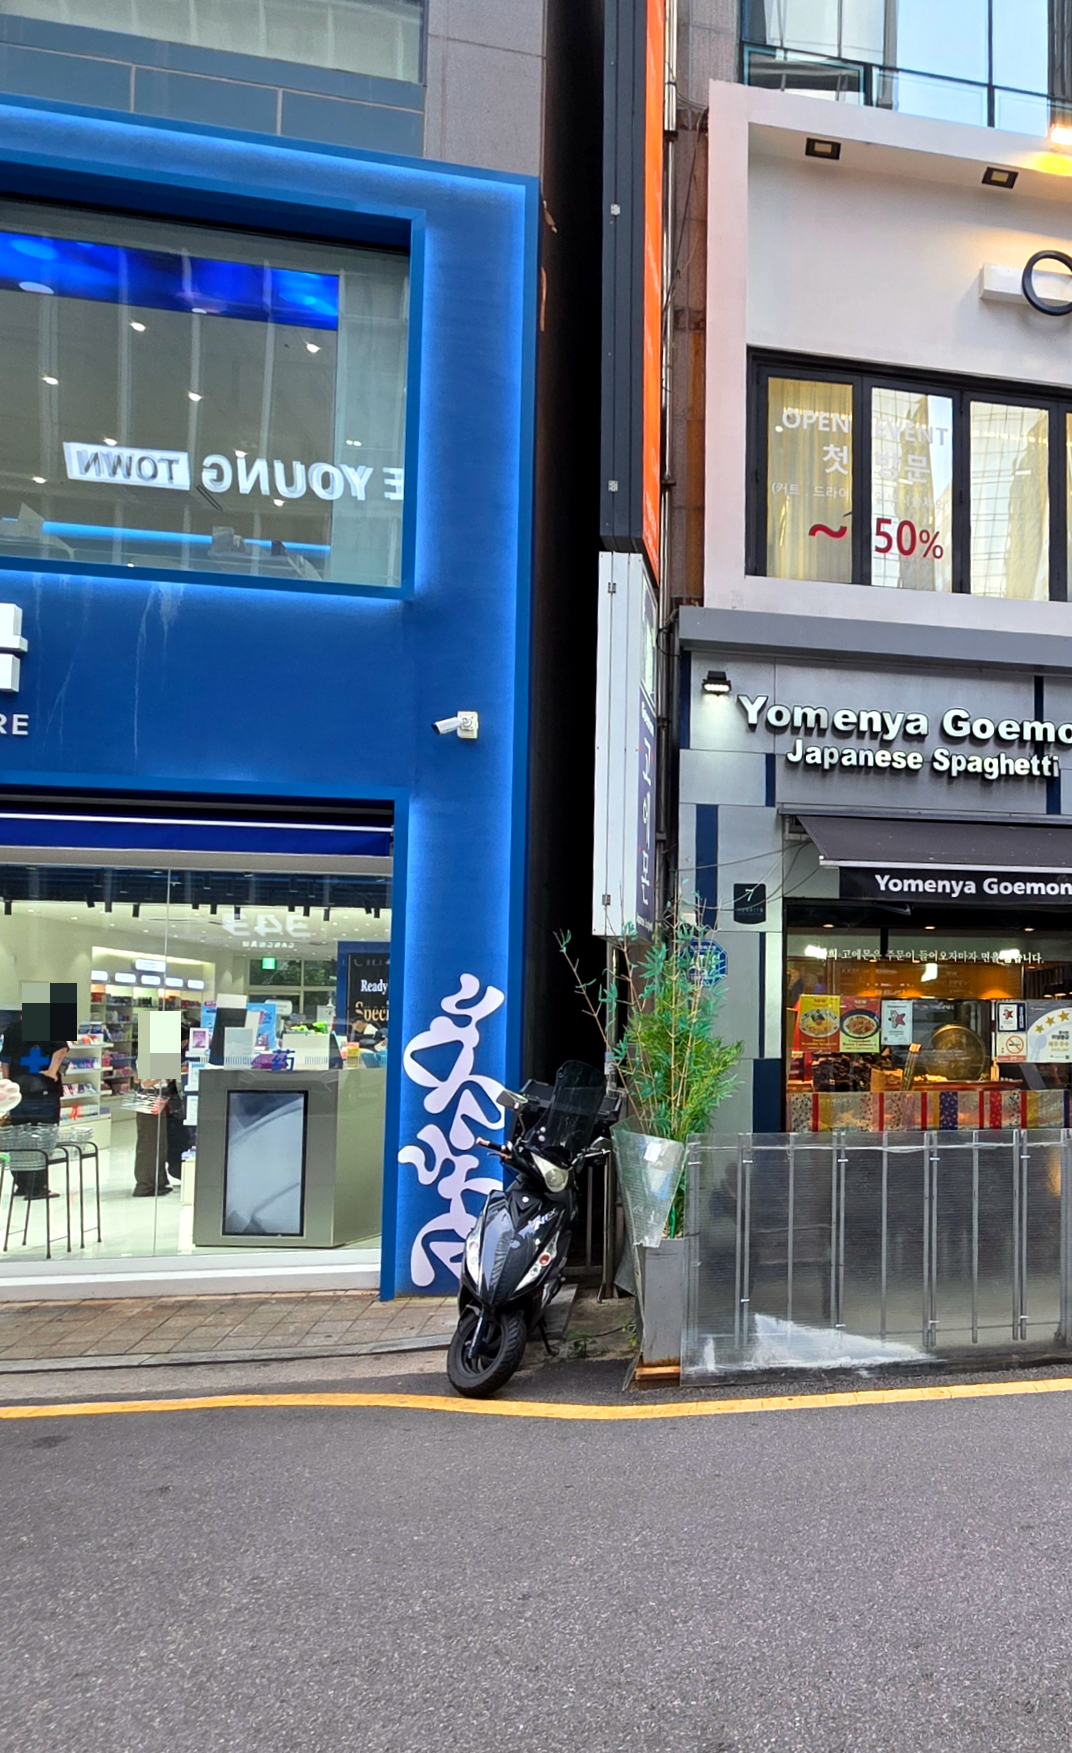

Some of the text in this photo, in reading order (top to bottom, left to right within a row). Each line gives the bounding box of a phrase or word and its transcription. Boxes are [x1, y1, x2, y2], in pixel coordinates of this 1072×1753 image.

[782, 408, 949, 446] OPEN EVENT
[822, 443, 850, 475] 첫
[874, 517, 944, 559] 50%
[738, 694, 929, 741] Yomenya
[787, 739, 1060, 780] Japanese Spaghetti
[875, 874, 976, 897] Yomenya
[360, 979, 389, 995] Ready
